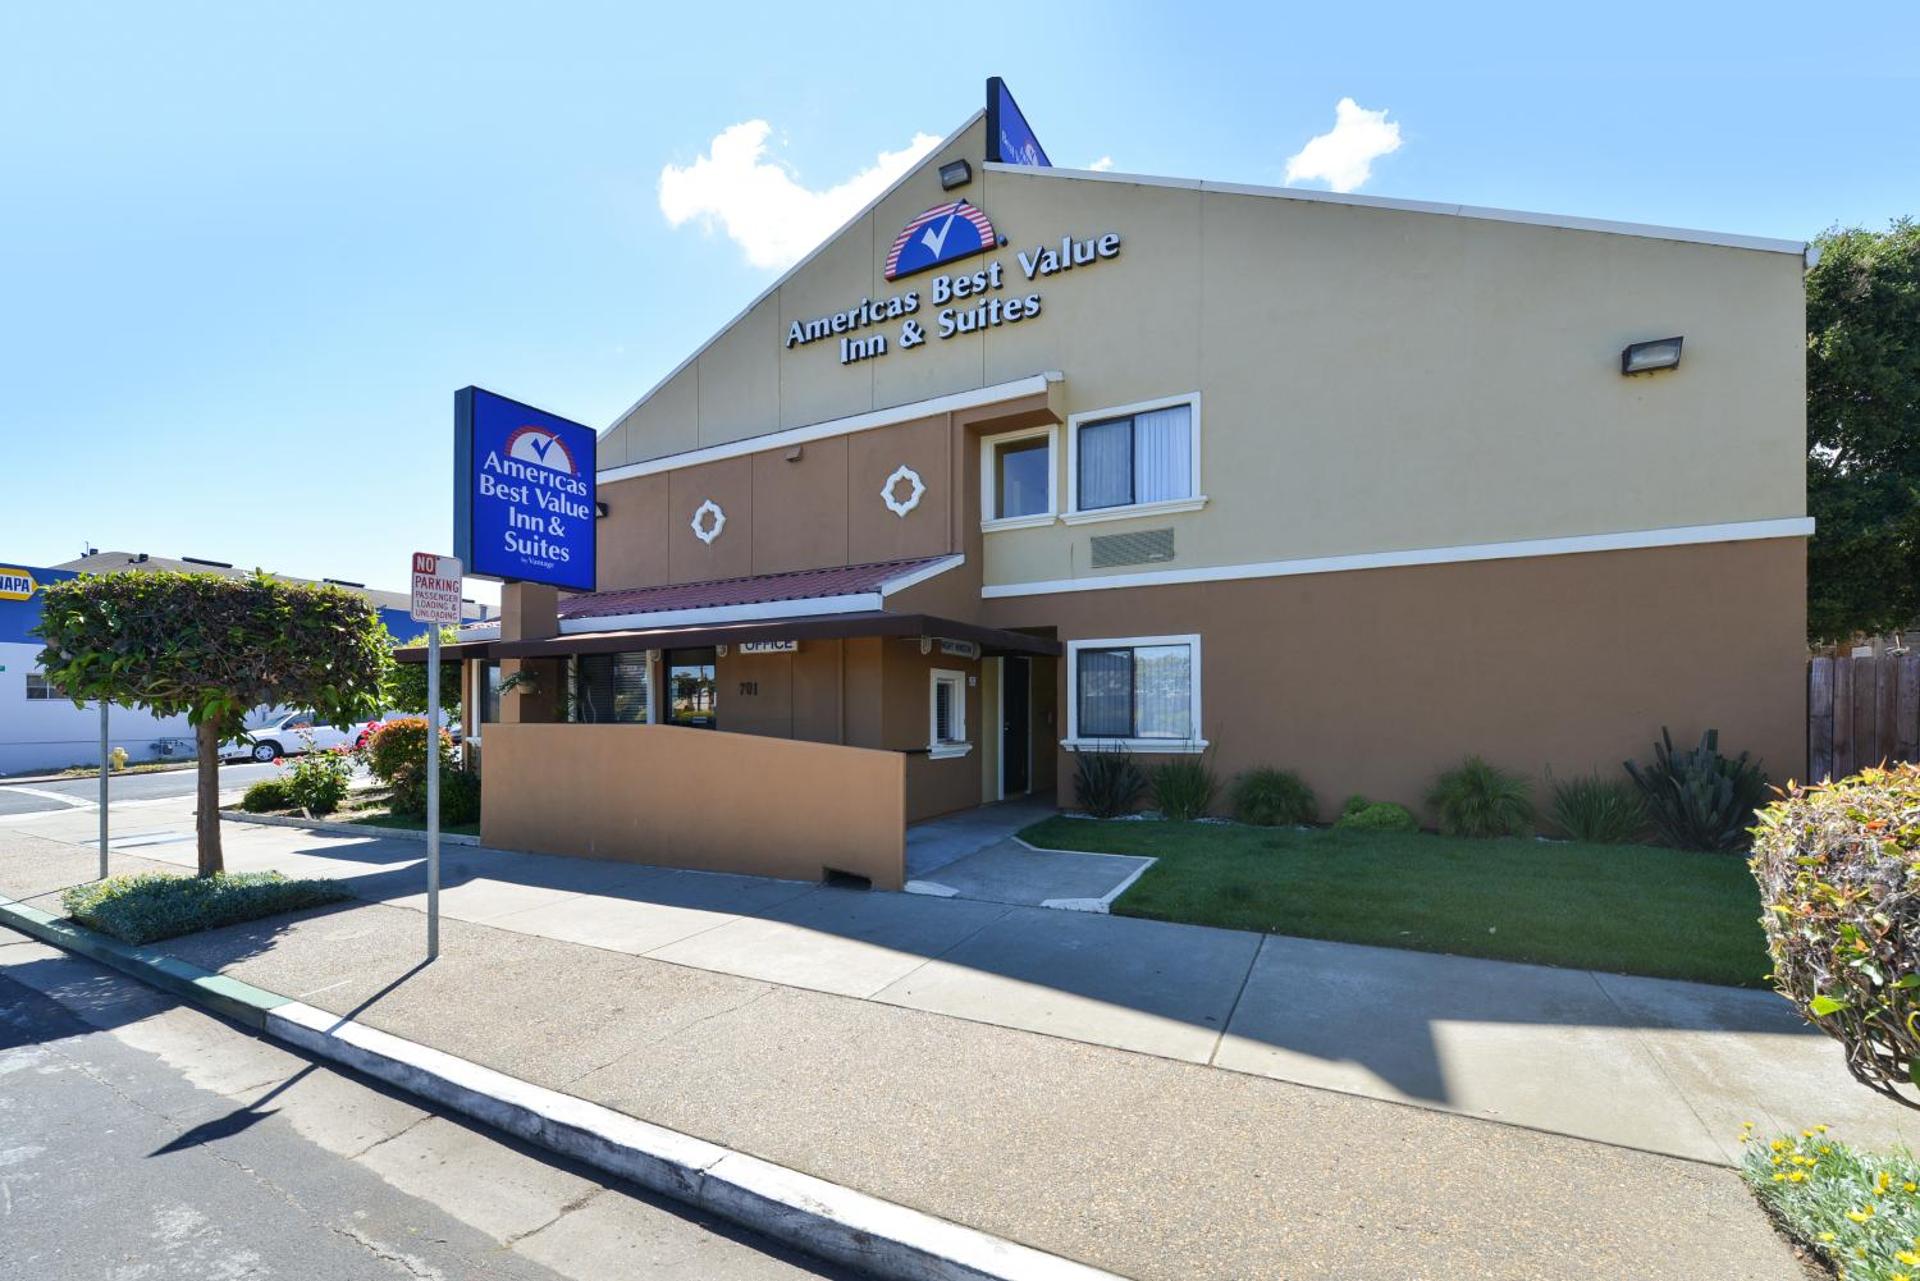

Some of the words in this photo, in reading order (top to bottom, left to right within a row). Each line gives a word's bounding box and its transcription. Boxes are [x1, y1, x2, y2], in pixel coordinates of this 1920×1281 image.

[786, 288, 919, 348] Americas
[932, 260, 1003, 306] Best
[1017, 232, 1121, 279] Value
[840, 333, 887, 365] Inn
[899, 319, 925, 349] &
[938, 292, 1041, 340] Suites
[483, 451, 587, 496] Americas
[480, 474, 529, 505] Best
[535, 488, 590, 520] Value
[509, 506, 543, 533] Inn
[548, 516, 565, 538] &
[504, 531, 569, 562] Suites
[416, 556, 434, 572] NO
[415, 576, 459, 593] PARKING
[415, 591, 458, 602] PASSENGER
[416, 600, 449, 610] LOADING
[415, 609, 458, 620] UNLOADING
[745, 640, 792, 650] OFFICE
[740, 682, 758, 696] 701
